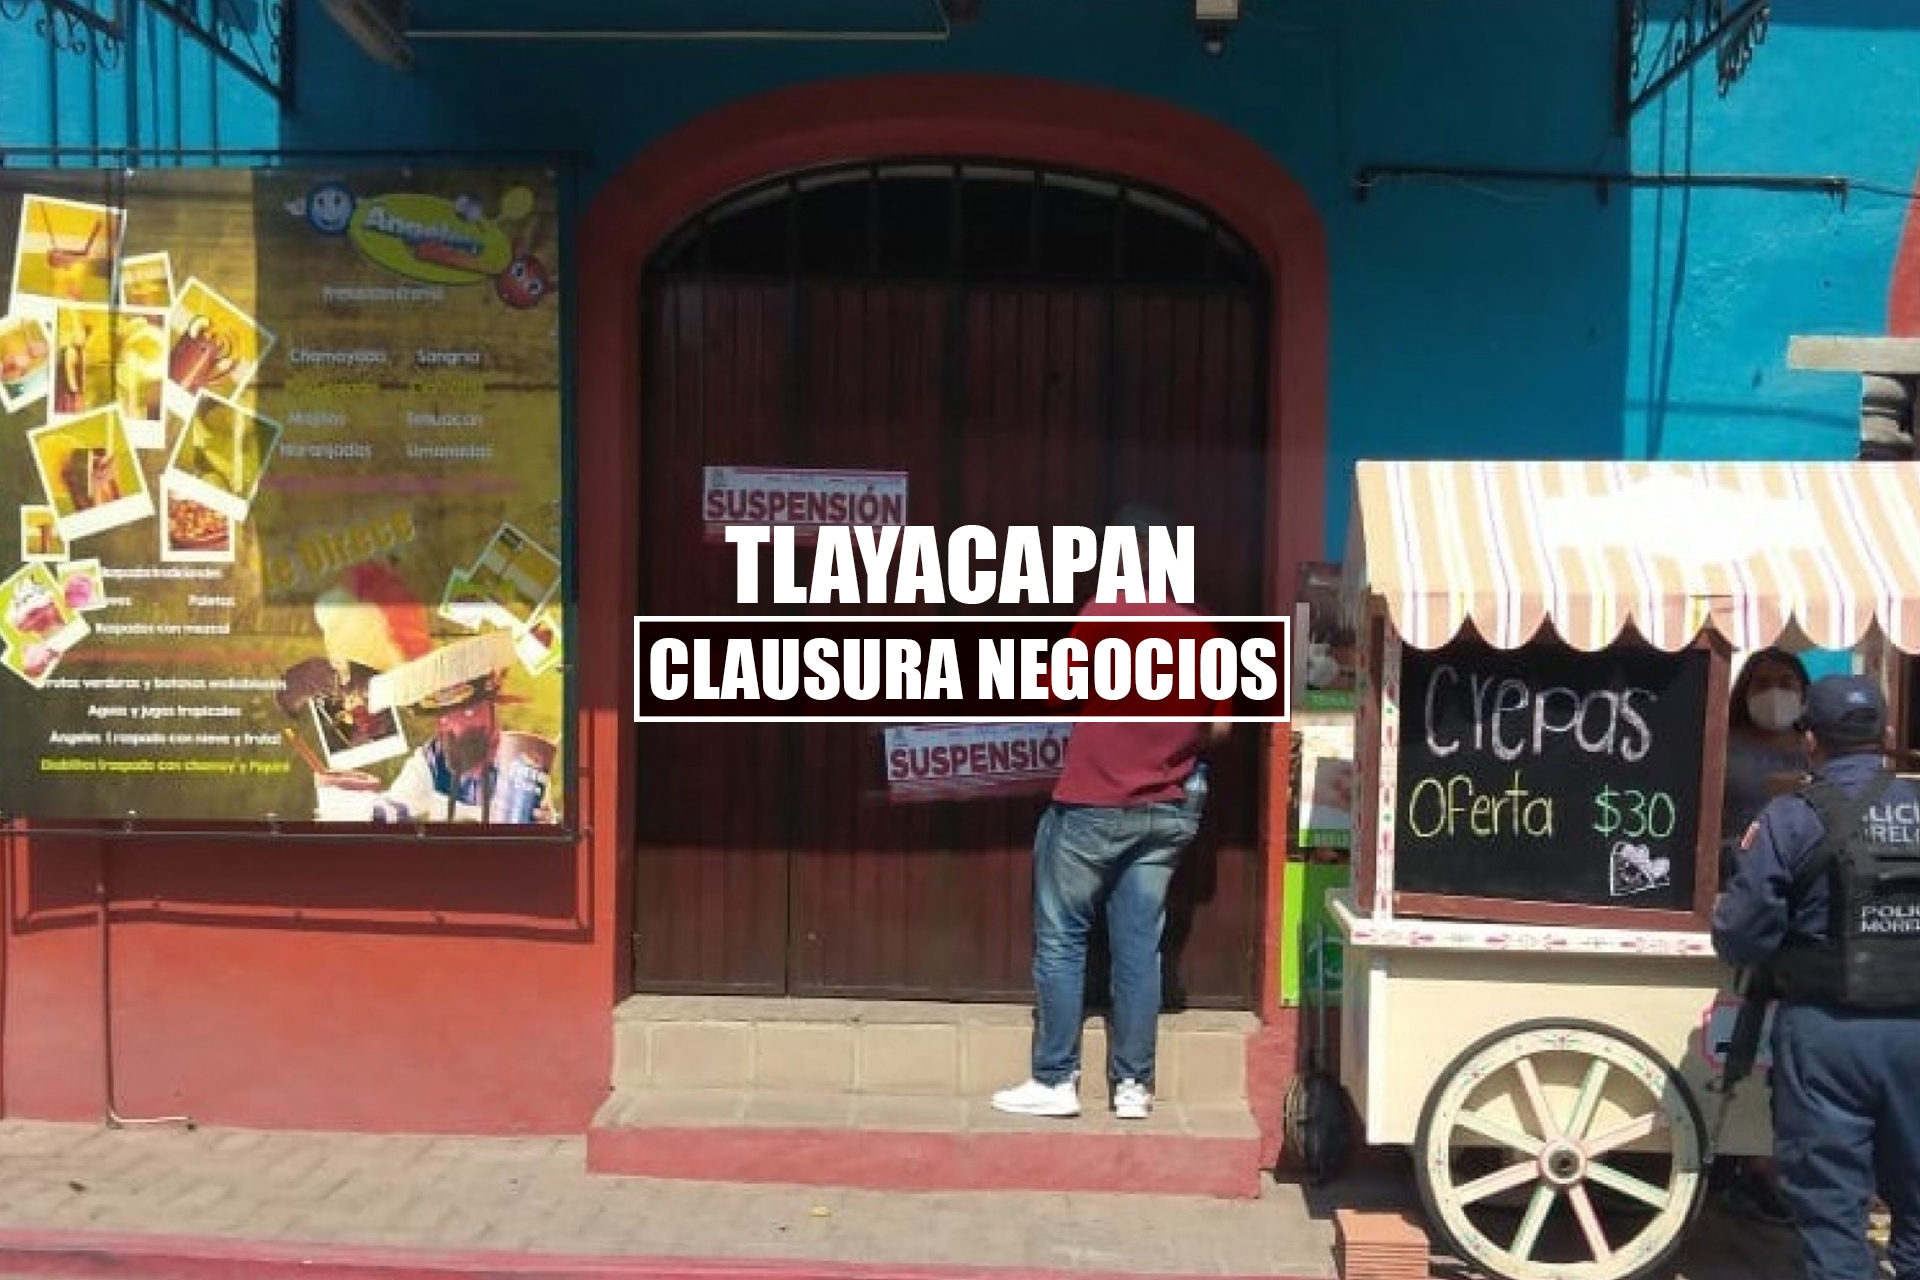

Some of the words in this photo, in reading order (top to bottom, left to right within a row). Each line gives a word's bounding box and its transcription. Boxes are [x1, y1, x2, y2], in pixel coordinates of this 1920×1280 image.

[706, 484, 903, 524] SUSPENSIÓN
[1425, 664, 1656, 762] Crepas
[890, 729, 1069, 779] SUSPENSIÓ
[1408, 769, 1553, 839] Oferta
[1593, 783, 1676, 839] $30
